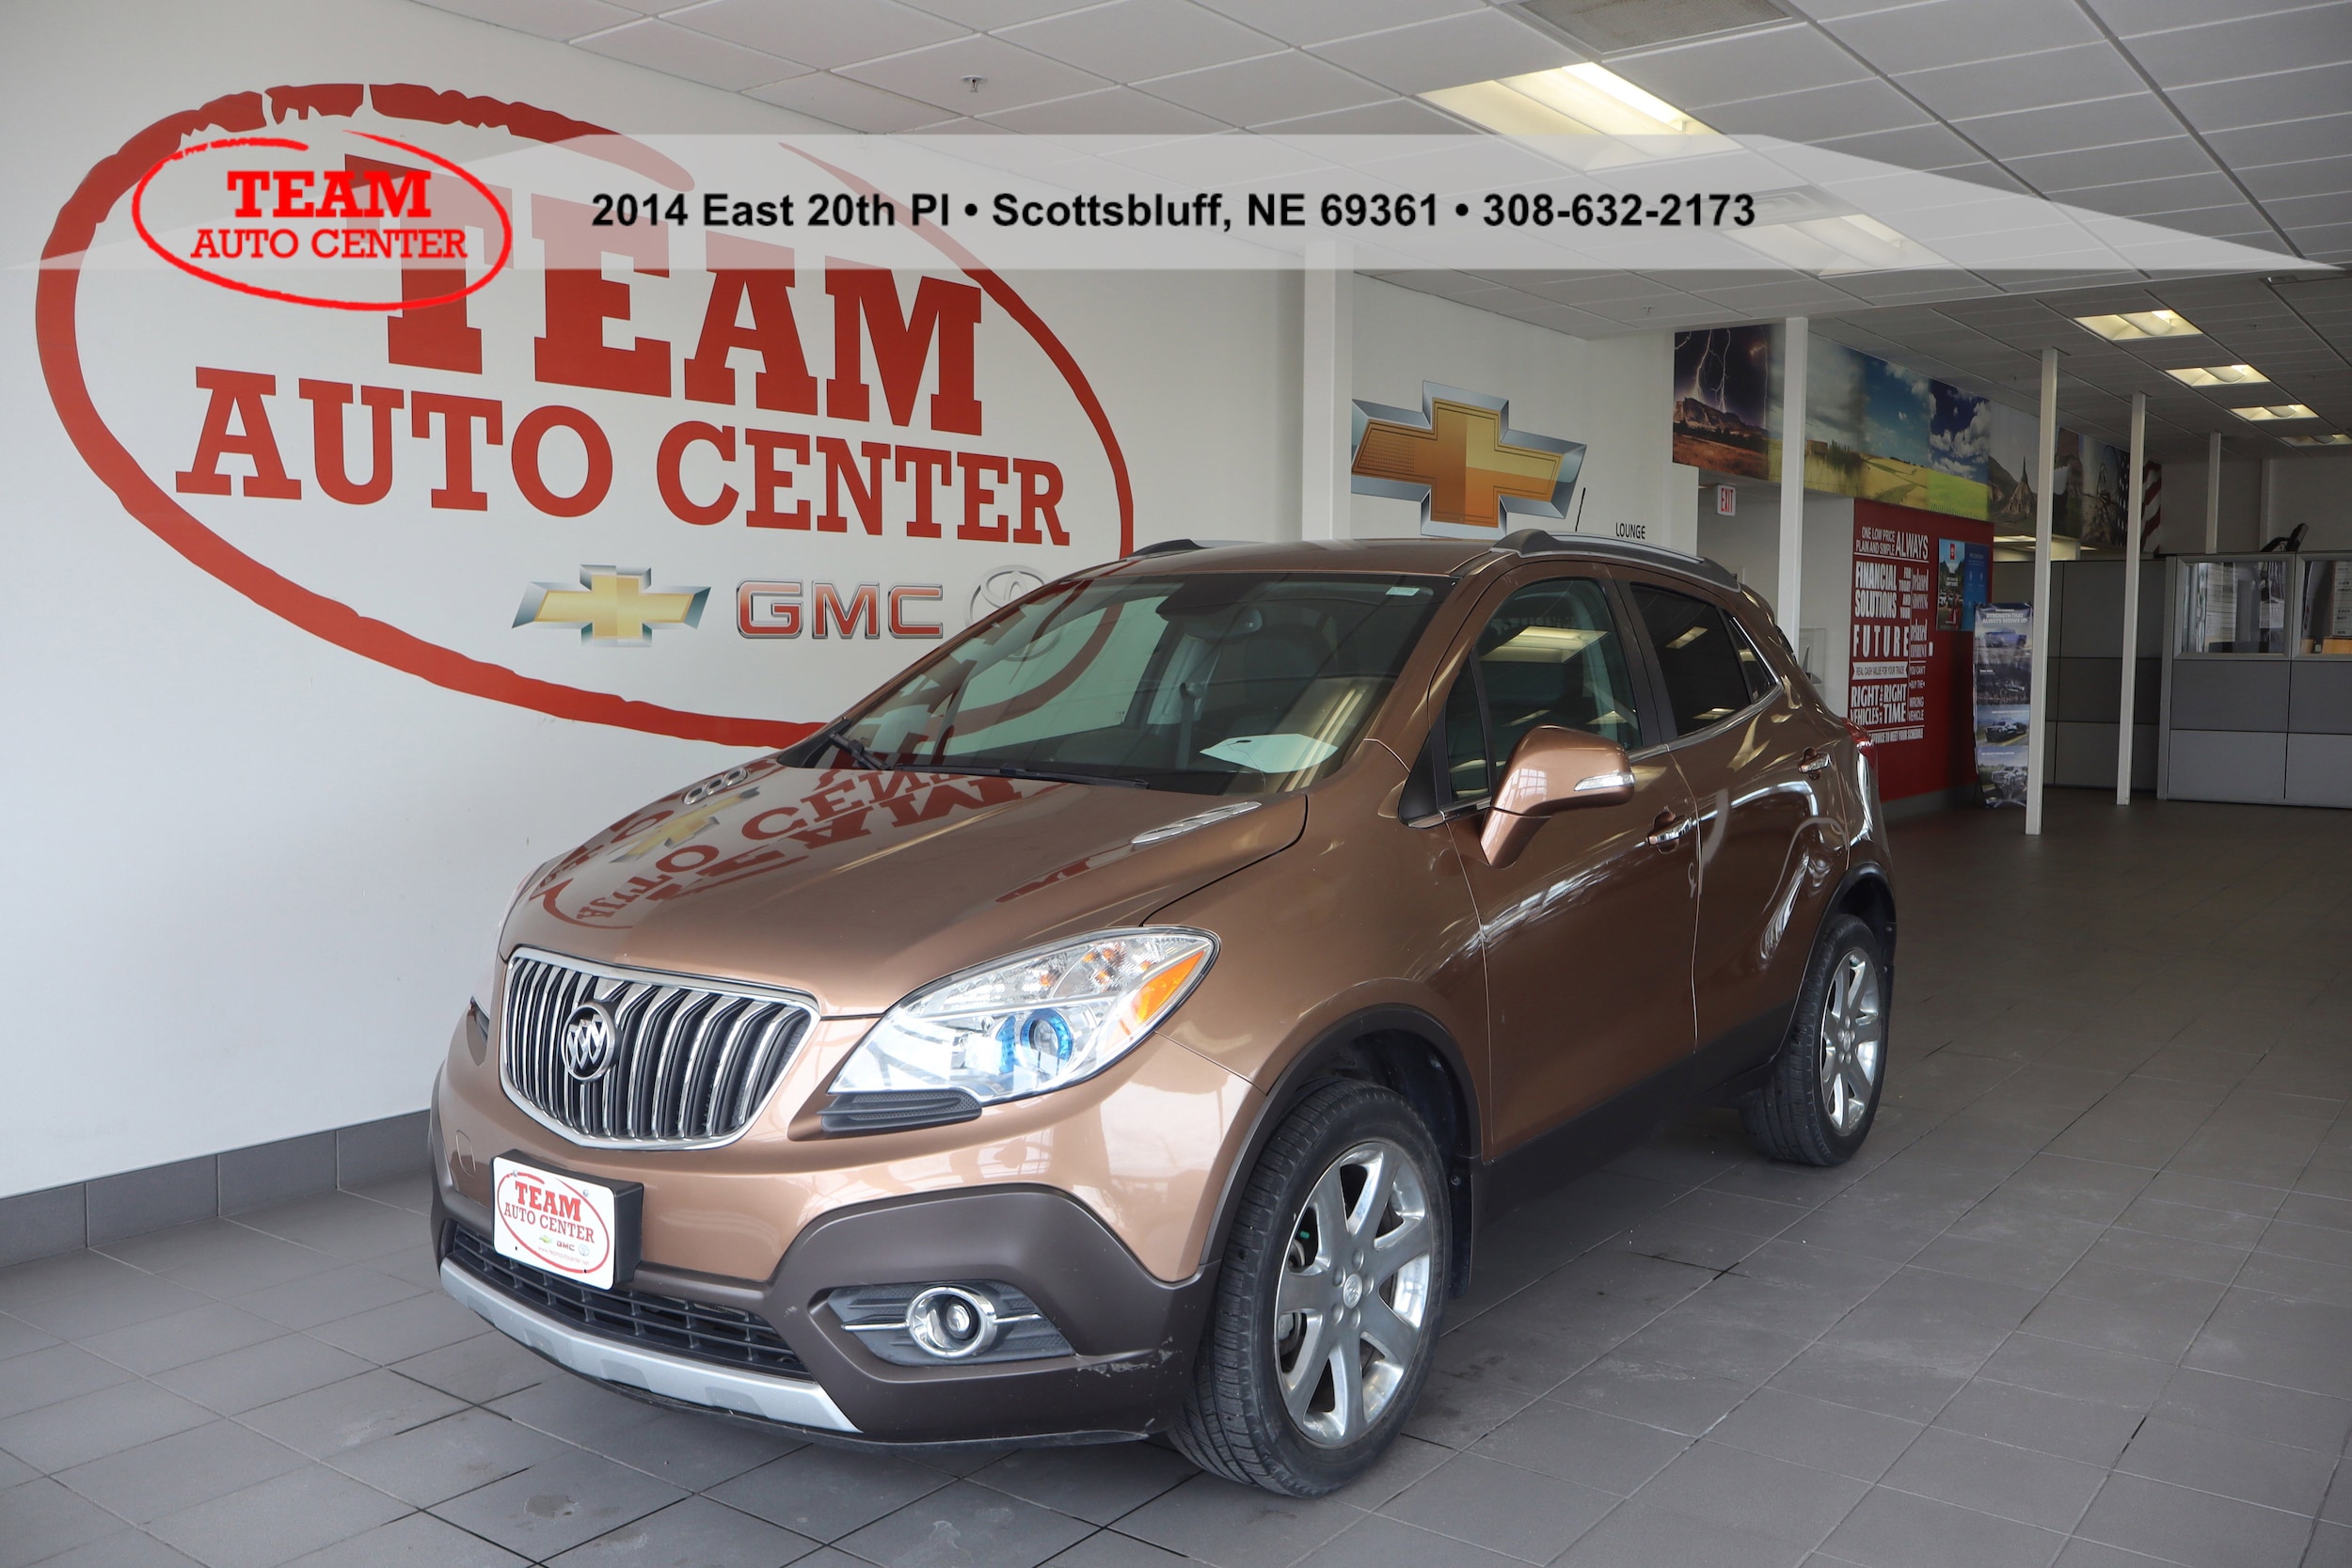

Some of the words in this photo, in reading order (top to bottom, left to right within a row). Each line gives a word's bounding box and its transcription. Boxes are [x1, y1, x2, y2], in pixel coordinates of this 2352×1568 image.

[344, 153, 982, 436] TEAM
[176, 366, 613, 517] AUTO
[657, 420, 1071, 546] CENTER
[1720, 486, 1734, 514] EXIT
[1615, 522, 1646, 540] LOUNGE
[1862, 527, 1871, 540] ONE
[1883, 530, 1896, 543] PRICE
[1895, 531, 1929, 561] ALWAYS
[1855, 561, 1897, 591] FINANCIAL
[736, 579, 945, 641] GMC
[1854, 589, 1897, 619] SOLUTIONS
[1852, 624, 1909, 657] FUTURE
[1851, 685, 1880, 708] RIGHT
[1883, 683, 1907, 704] RIGHT
[1850, 706, 1880, 726] VEHICLES
[1883, 702, 1907, 724] TIME
[515, 1180, 581, 1222] TEAM
[503, 1201, 536, 1225] AUTO
[539, 1214, 596, 1243] CENTER
[556, 1241, 575, 1252] GMC
